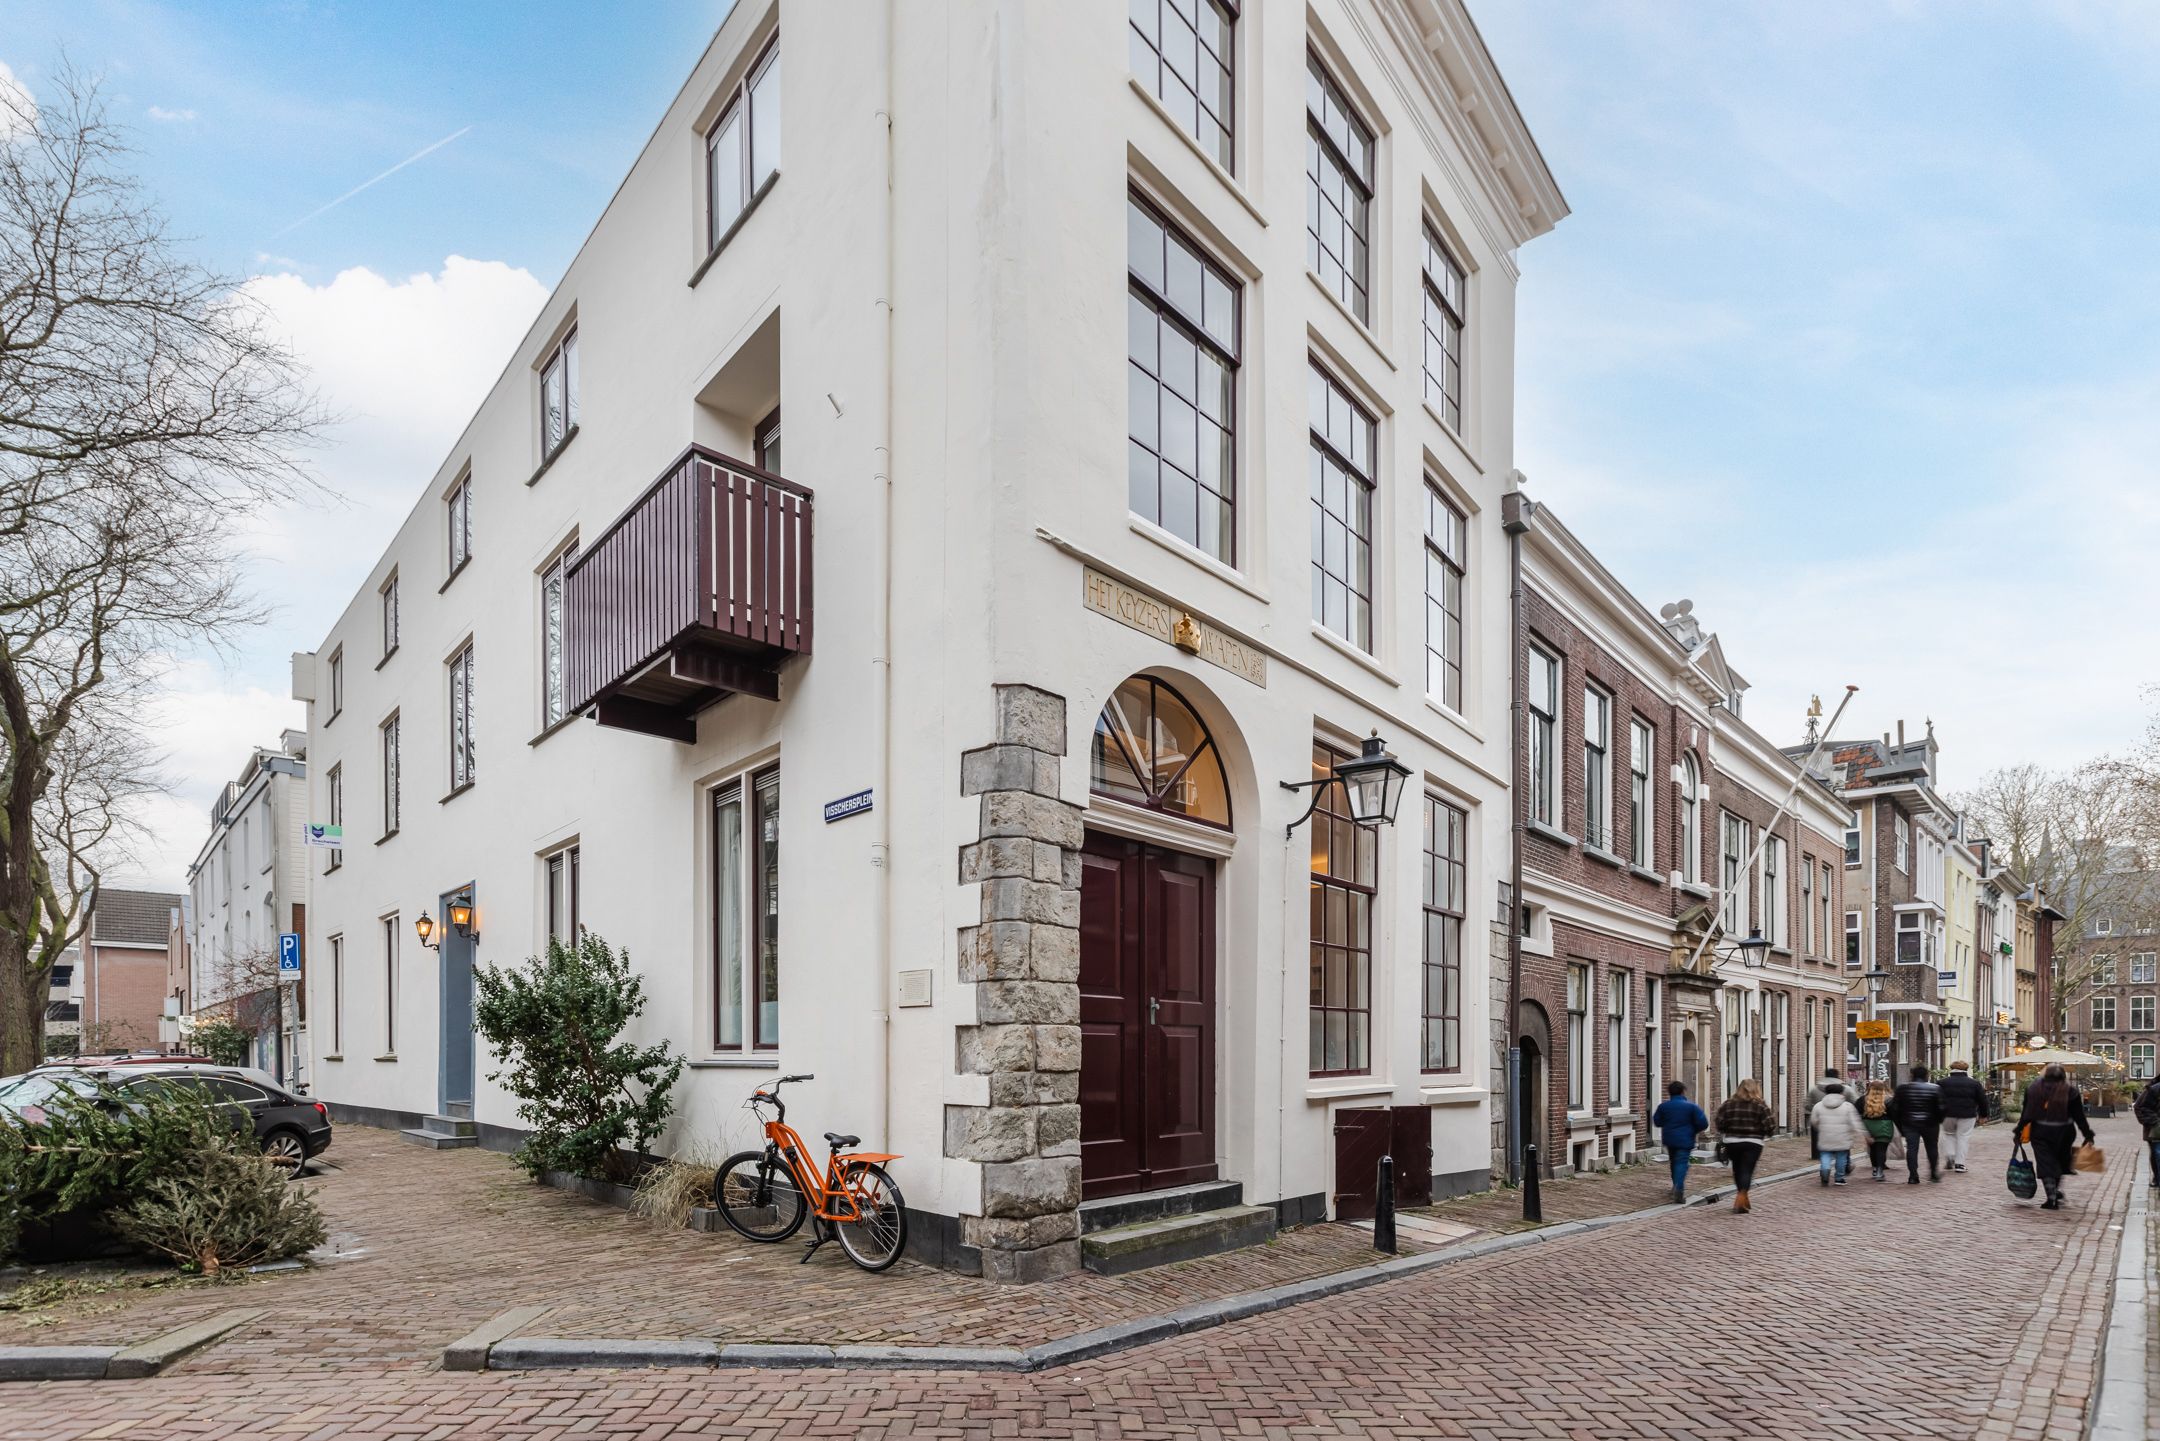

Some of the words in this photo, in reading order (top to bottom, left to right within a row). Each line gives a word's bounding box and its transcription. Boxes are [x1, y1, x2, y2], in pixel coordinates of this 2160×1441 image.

[1088, 574, 1113, 611] HET
[1116, 587, 1169, 635] KEYZERS
[825, 792, 873, 818] VISSCHERSPLEIN
[283, 936, 294, 956] P
